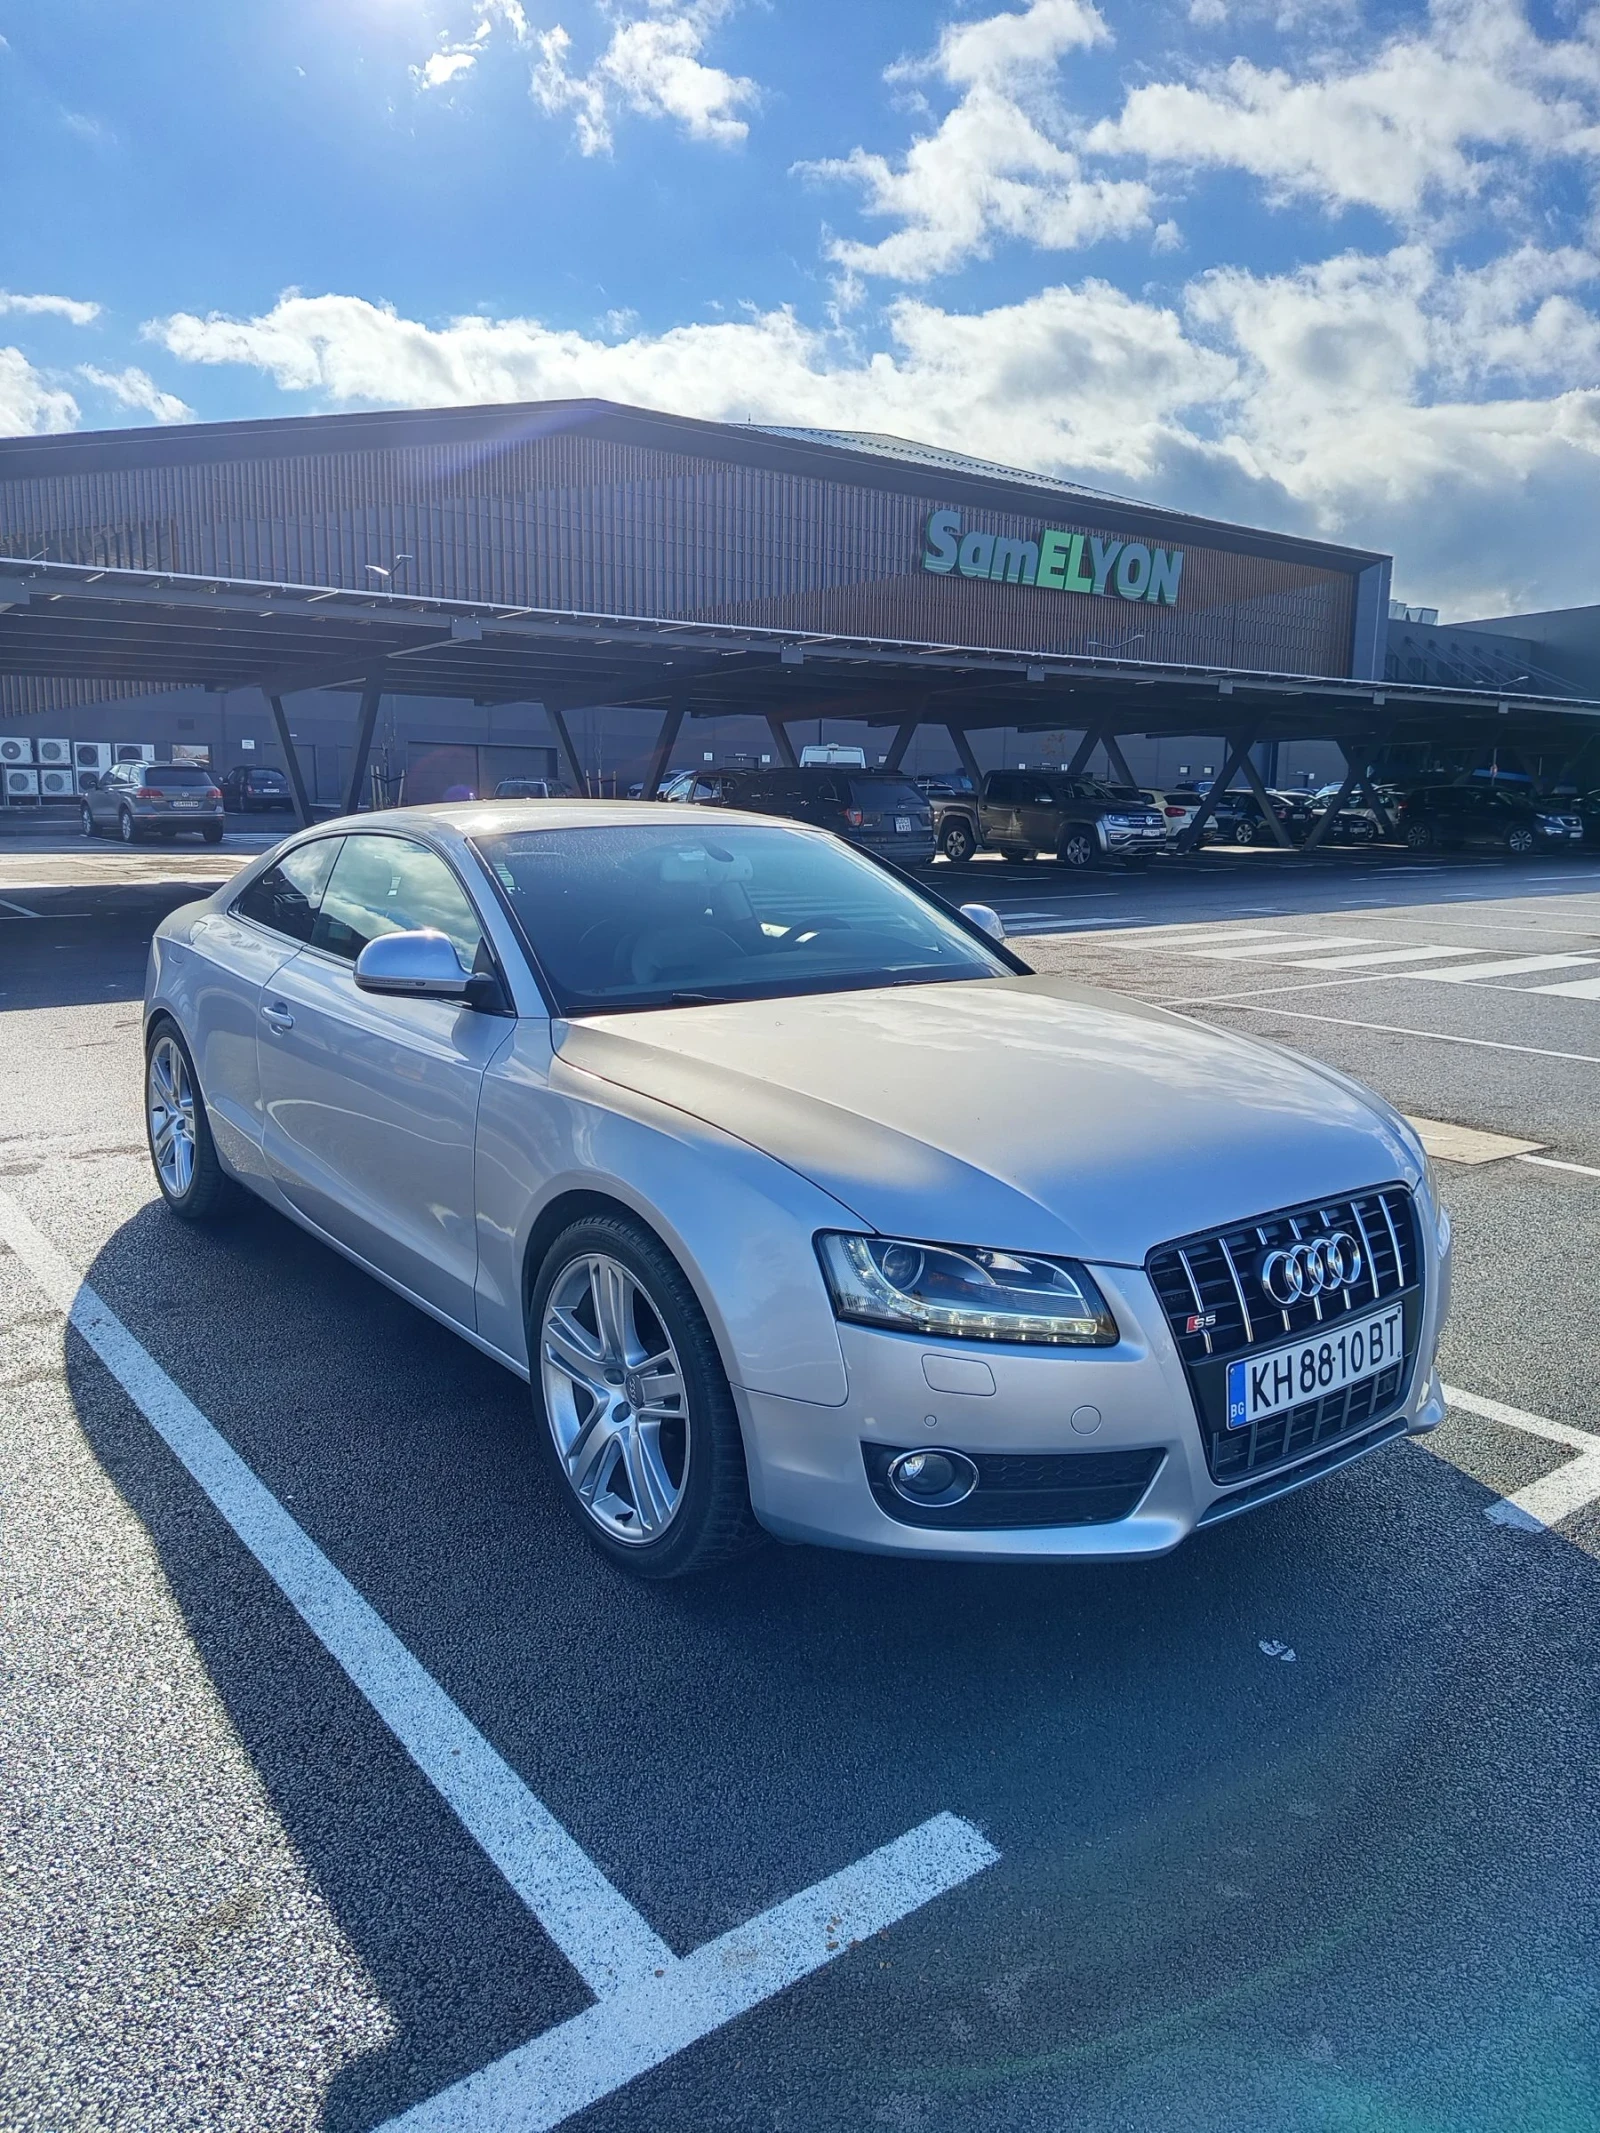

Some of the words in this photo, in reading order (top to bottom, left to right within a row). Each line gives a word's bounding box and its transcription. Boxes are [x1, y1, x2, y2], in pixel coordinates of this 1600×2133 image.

[922, 509, 1184, 606] SamELYON
[1193, 1314, 1217, 1329] S5
[1230, 1401, 1245, 1417] BG
